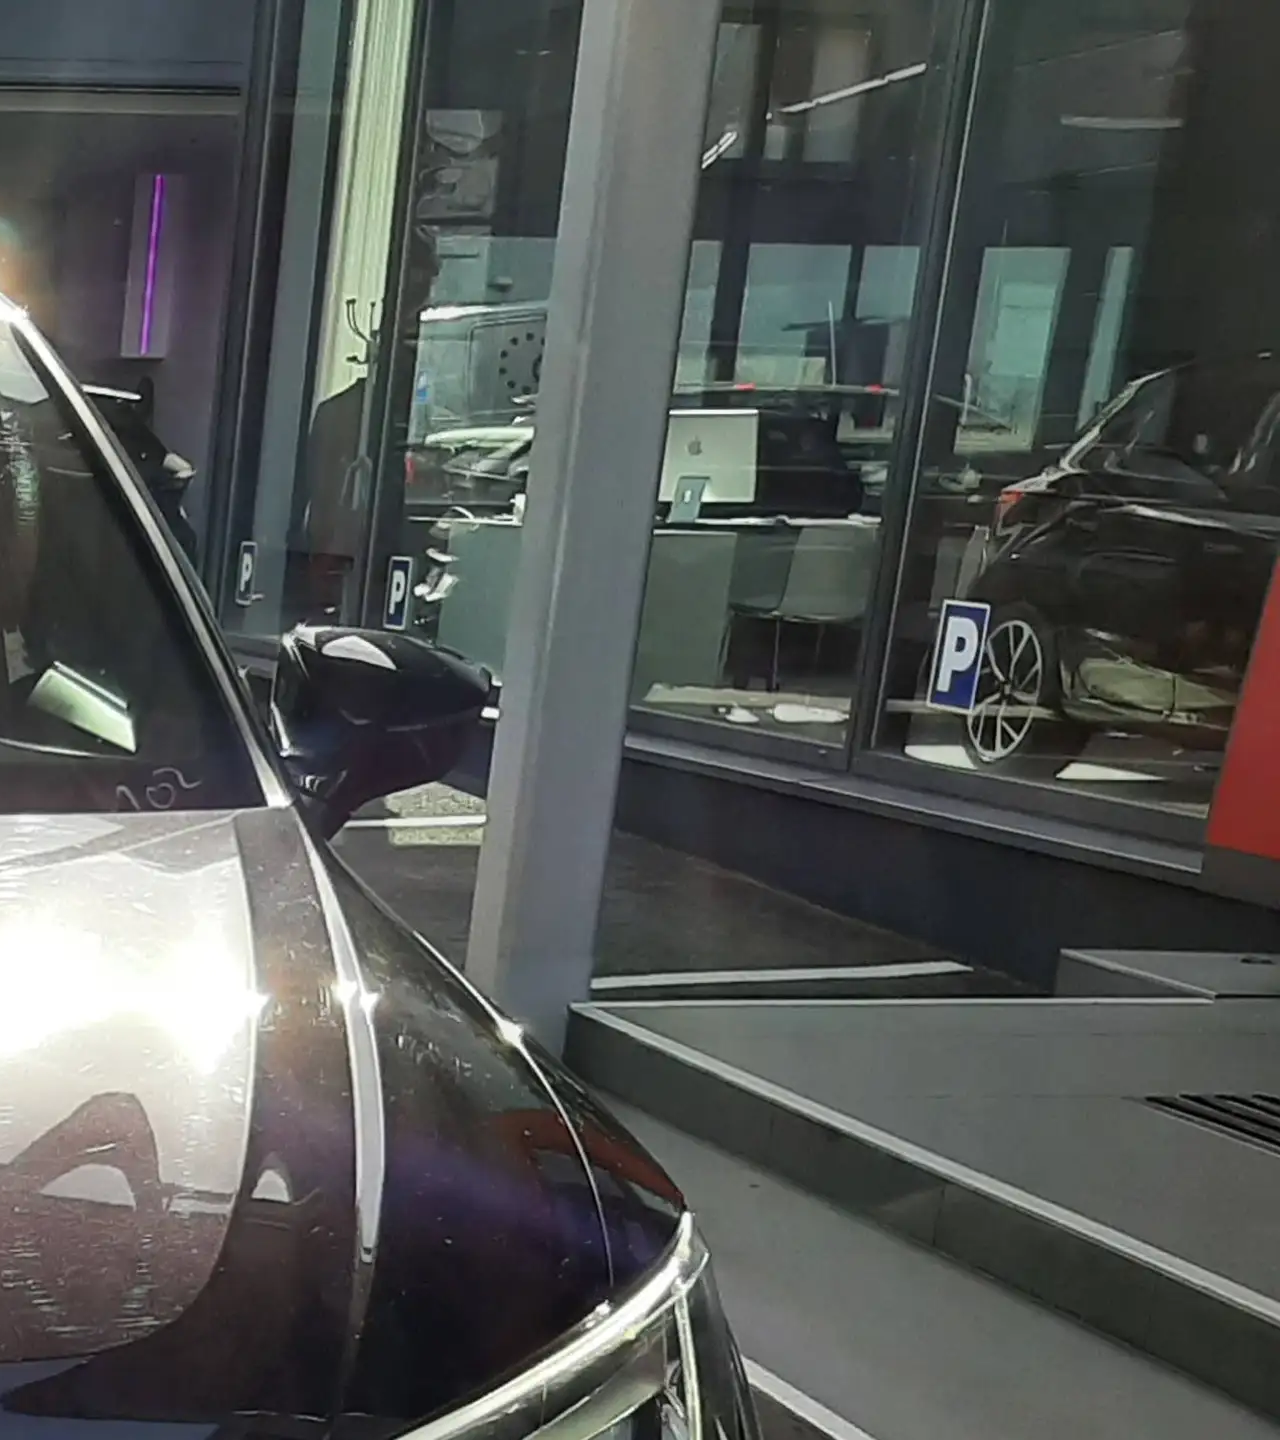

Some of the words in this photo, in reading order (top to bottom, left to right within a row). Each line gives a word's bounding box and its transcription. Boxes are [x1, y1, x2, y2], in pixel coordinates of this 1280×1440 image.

[240, 552, 253, 592] P
[389, 569, 406, 615] P
[937, 616, 979, 692] P
